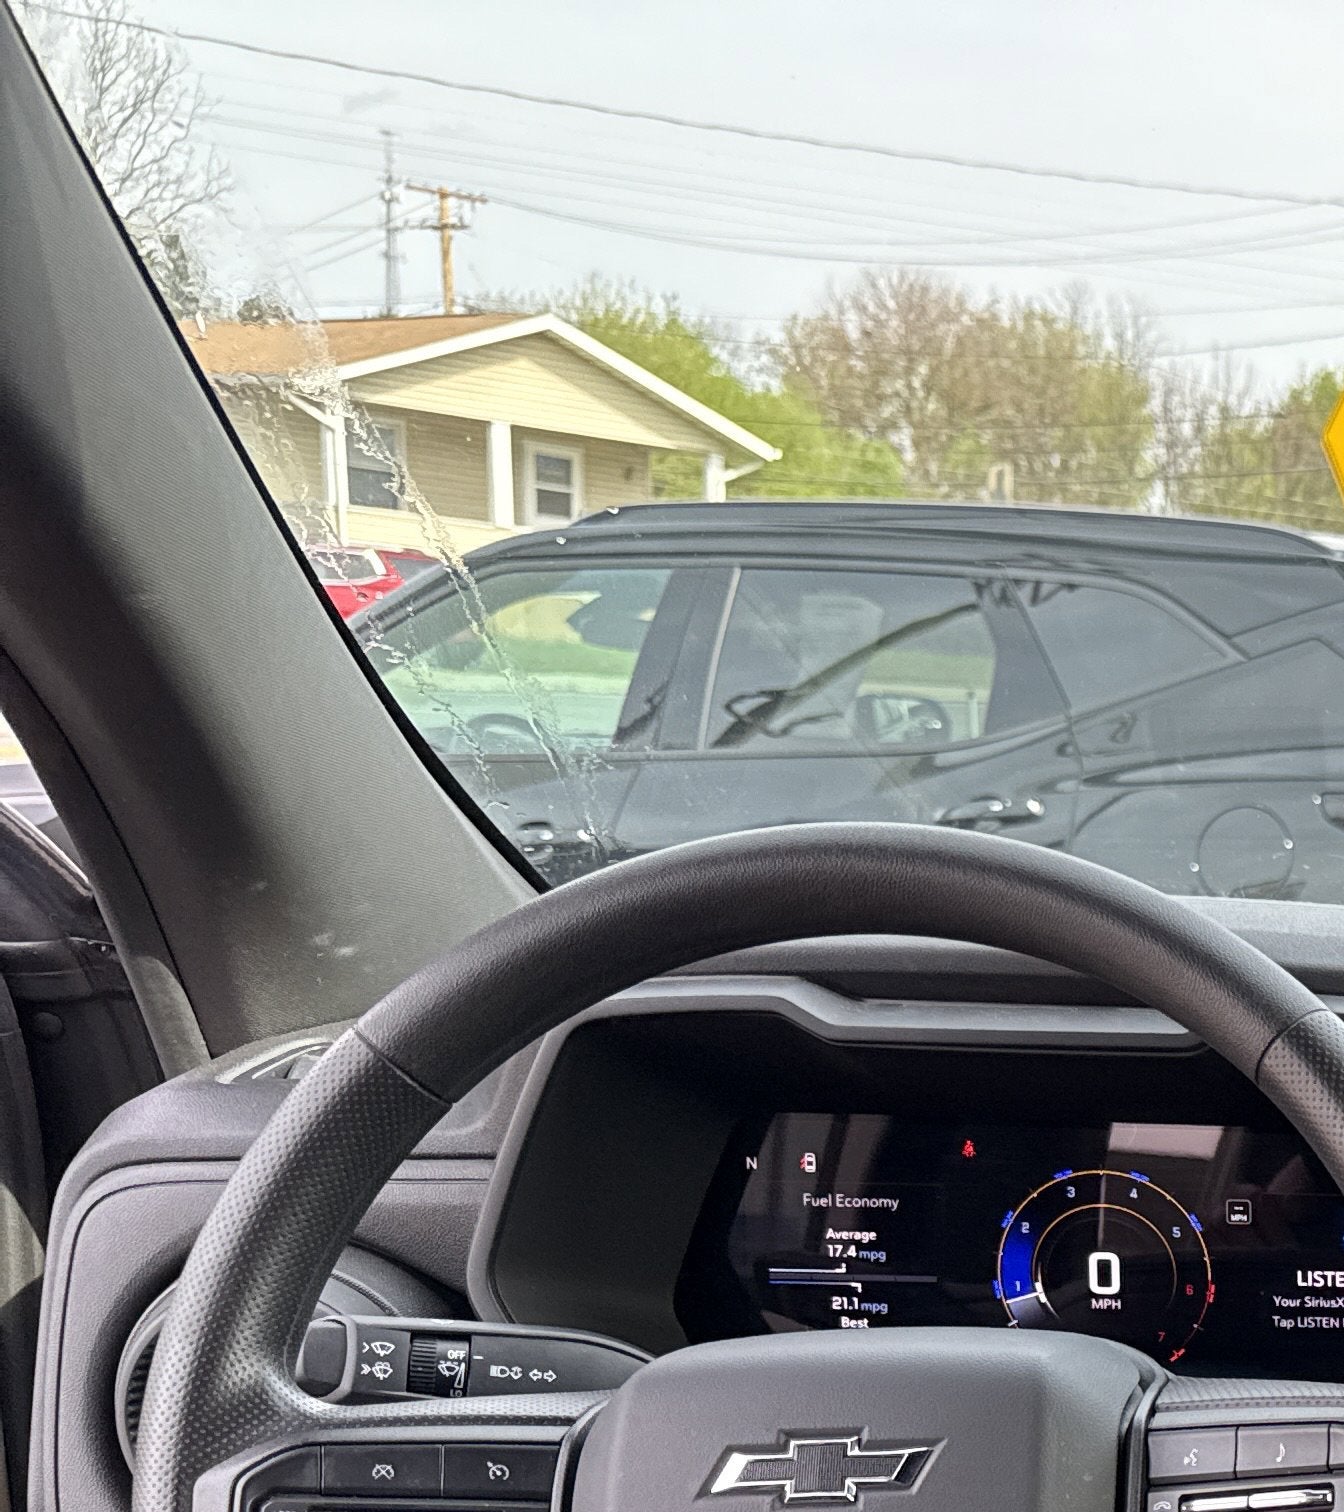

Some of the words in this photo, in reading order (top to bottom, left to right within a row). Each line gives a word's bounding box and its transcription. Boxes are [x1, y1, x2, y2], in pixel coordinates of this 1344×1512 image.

[746, 1157, 758, 1170] N
[1066, 1186, 1076, 1198] 3
[1130, 1188, 1138, 1199] 4
[802, 1193, 832, 1207] Fuel
[835, 1194, 900, 1211] Economy
[1021, 1222, 1030, 1233] 2
[1172, 1227, 1181, 1238] 5
[825, 1228, 877, 1243] Average
[827, 1245, 857, 1258] 17.4
[858, 1250, 887, 1262] mpg
[1088, 1252, 1121, 1295] 0
[1015, 1280, 1021, 1292] 1
[1186, 1284, 1194, 1295] 6
[832, 1297, 858, 1310] 21.1
[861, 1302, 888, 1314] mpg
[1091, 1298, 1122, 1309] MPH
[1272, 1295, 1301, 1308] Your
[841, 1316, 869, 1329] Best
[1272, 1315, 1295, 1330] Tap
[1297, 1317, 1340, 1328] LISTEN
[1158, 1331, 1166, 1342] 7
[447, 1349, 467, 1360] OFF
